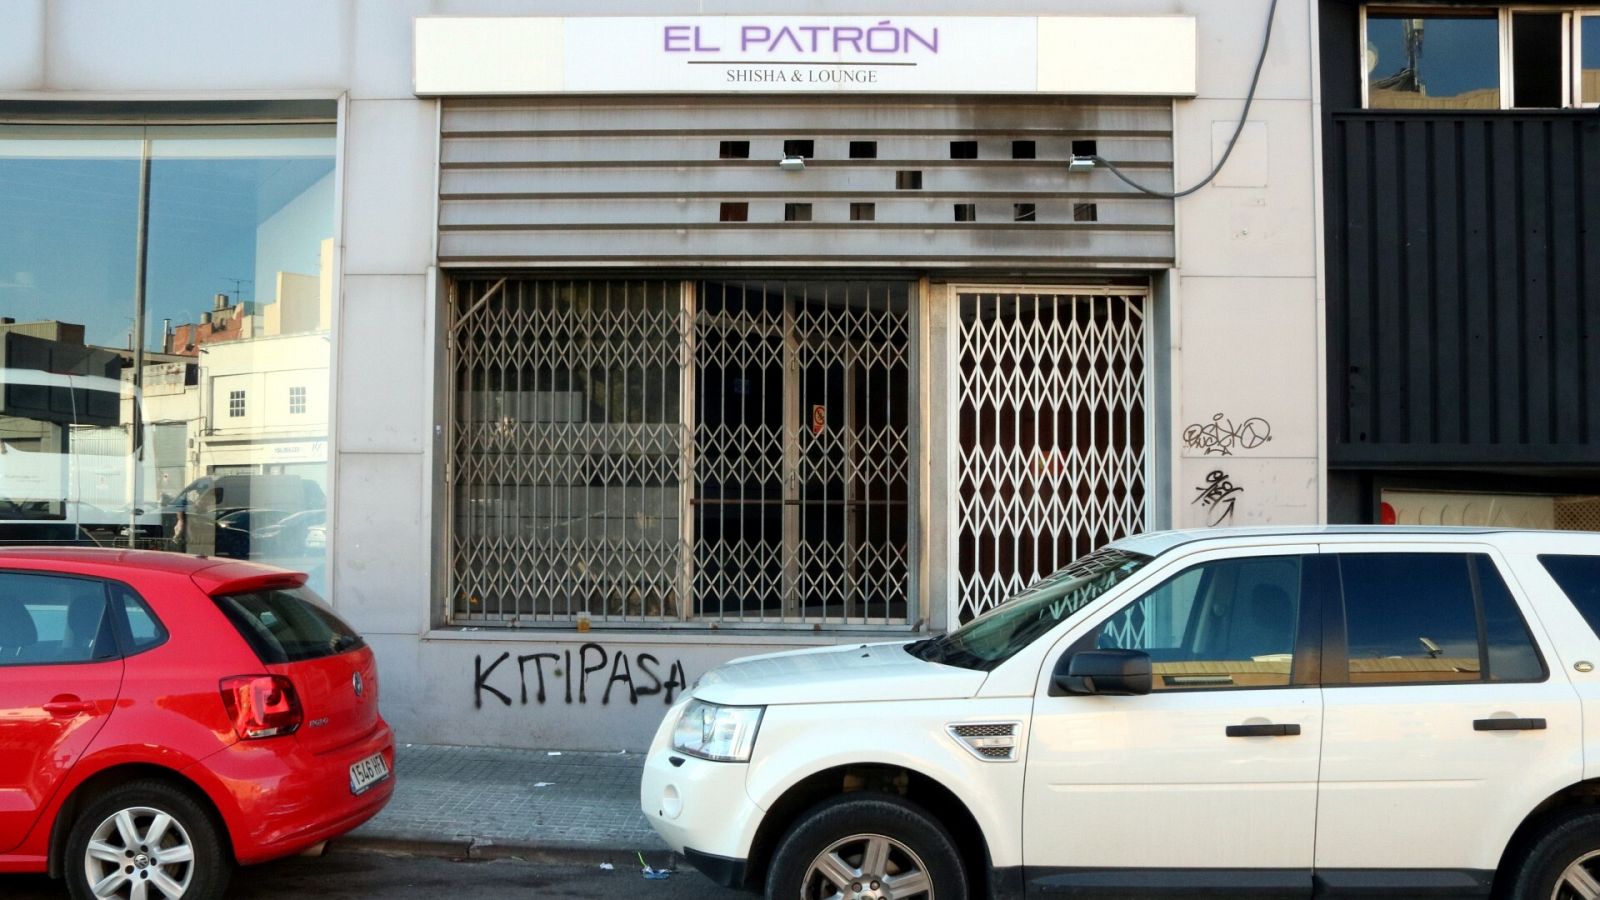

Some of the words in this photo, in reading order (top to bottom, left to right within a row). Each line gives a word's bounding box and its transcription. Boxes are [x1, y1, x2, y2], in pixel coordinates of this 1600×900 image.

[664, 26, 720, 52] EL
[741, 20, 938, 54] PATRÓN
[726, 69, 787, 83] SHISHA
[790, 70, 804, 83] &
[808, 69, 878, 83] LOUNGE
[352, 762, 374, 785] 1546
